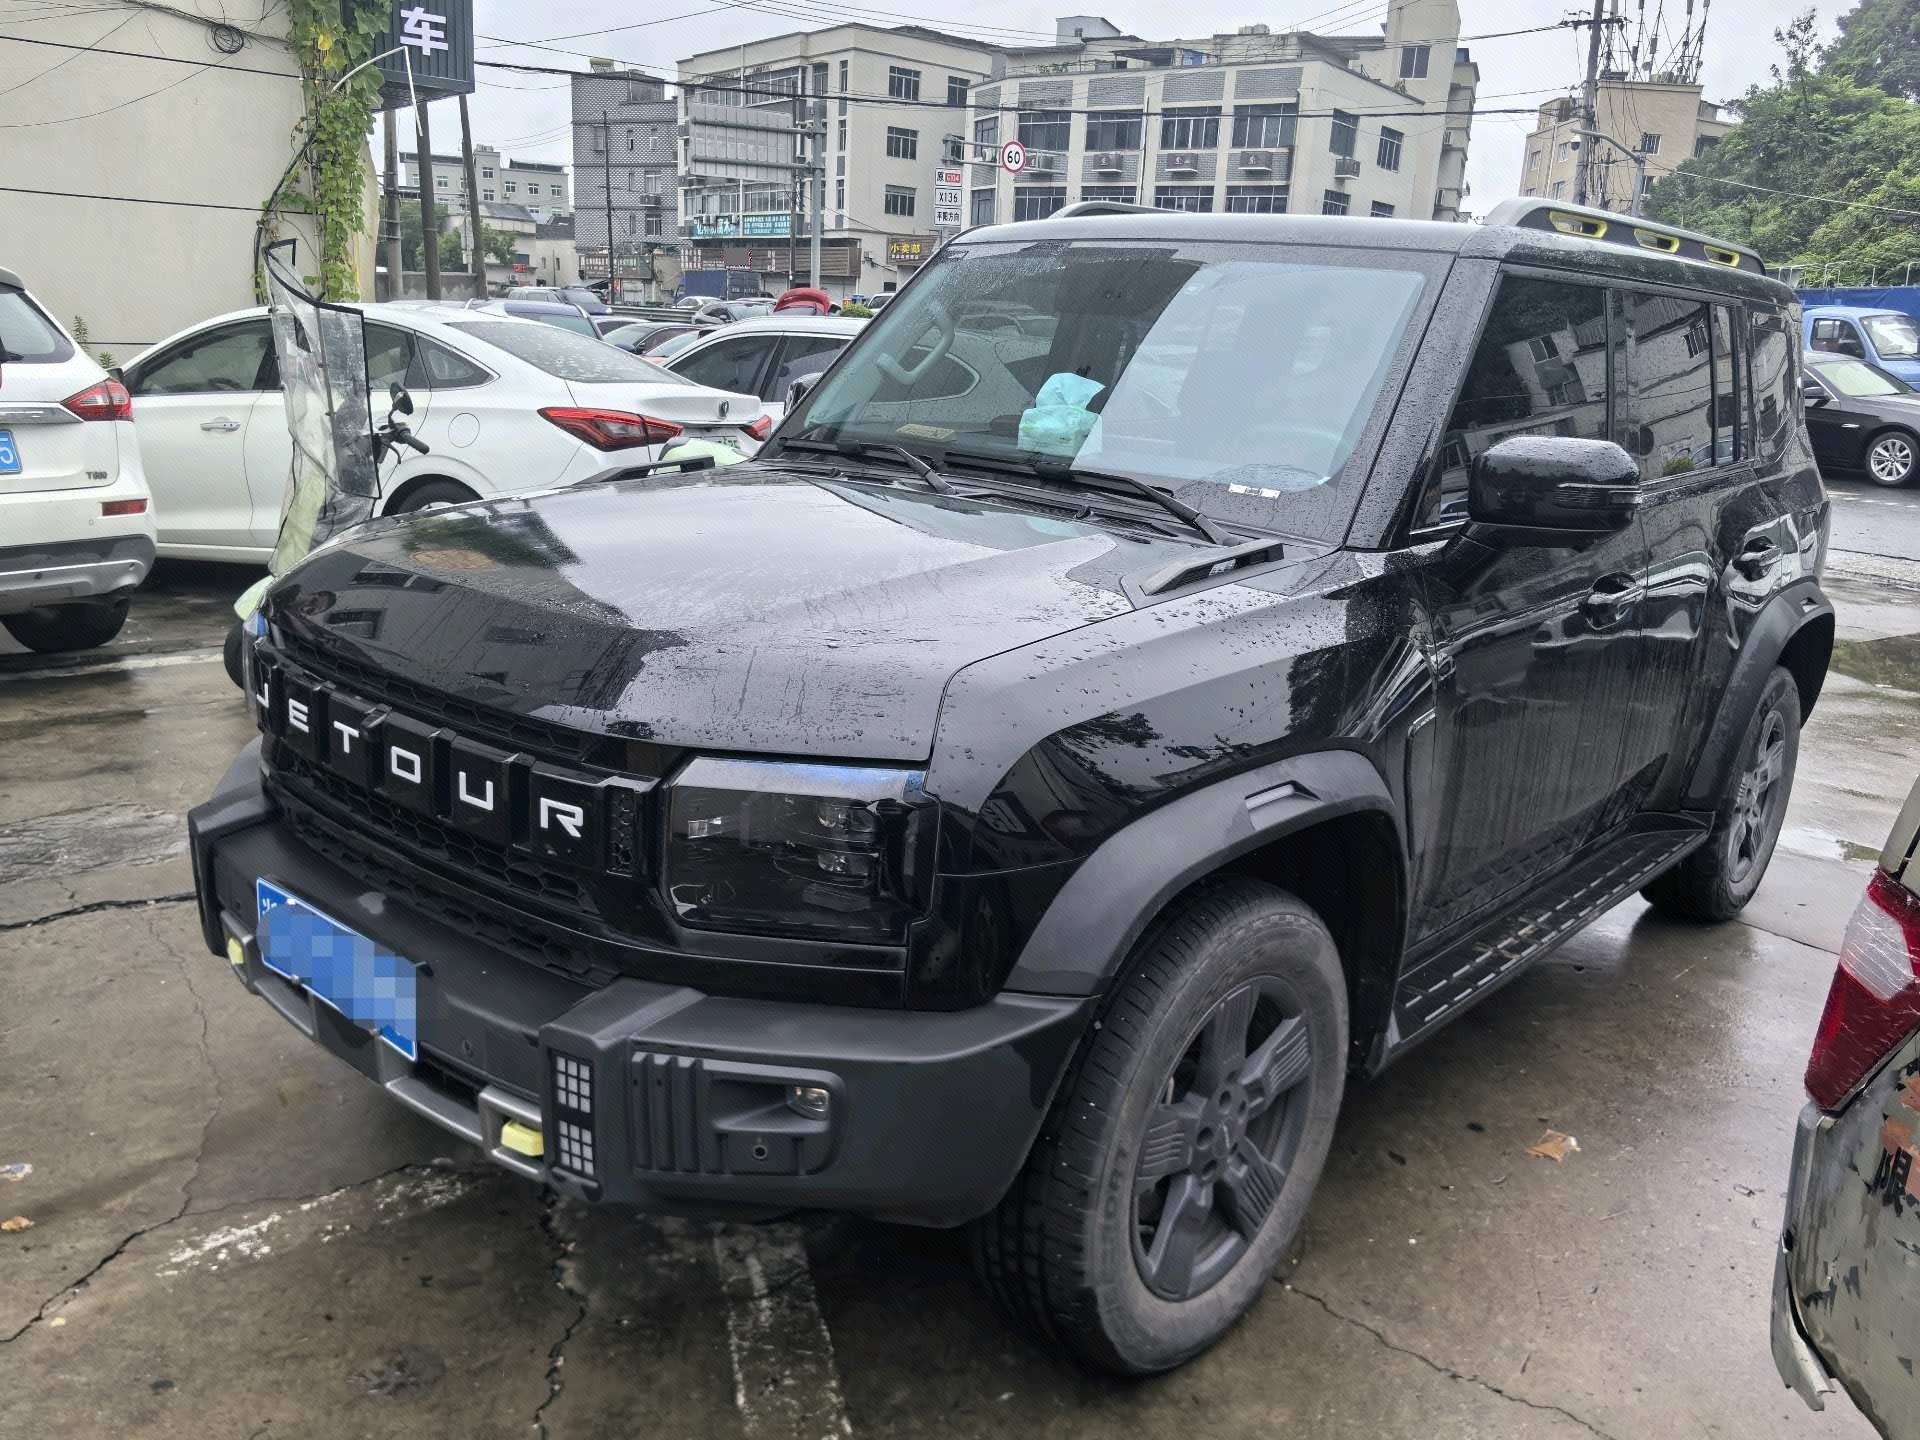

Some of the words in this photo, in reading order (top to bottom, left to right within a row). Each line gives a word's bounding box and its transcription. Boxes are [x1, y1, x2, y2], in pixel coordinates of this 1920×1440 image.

[400, 6, 449, 56] 车
[1007, 150, 1020, 165] 60
[939, 192, 958, 203] X136
[890, 242, 921, 254] 小卖部
[256, 683, 584, 838] JETOUR
